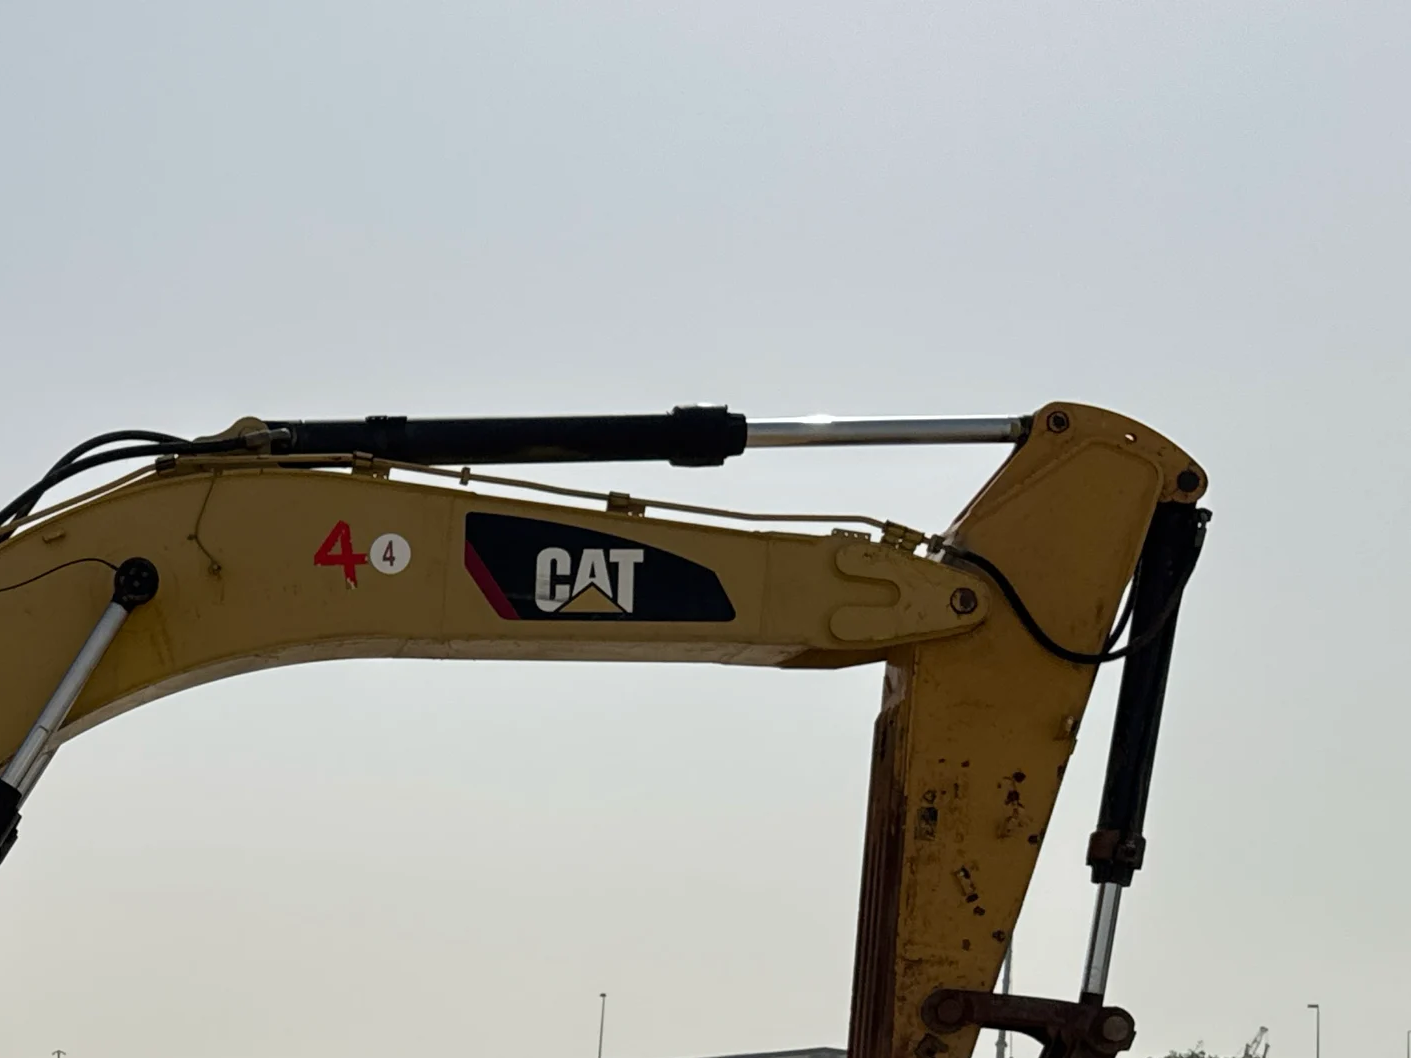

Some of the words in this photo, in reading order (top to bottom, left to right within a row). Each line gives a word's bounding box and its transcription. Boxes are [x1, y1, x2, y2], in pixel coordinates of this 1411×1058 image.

[313, 519, 368, 589] 4
[382, 539, 396, 567] 4
[534, 546, 645, 614] CAT
